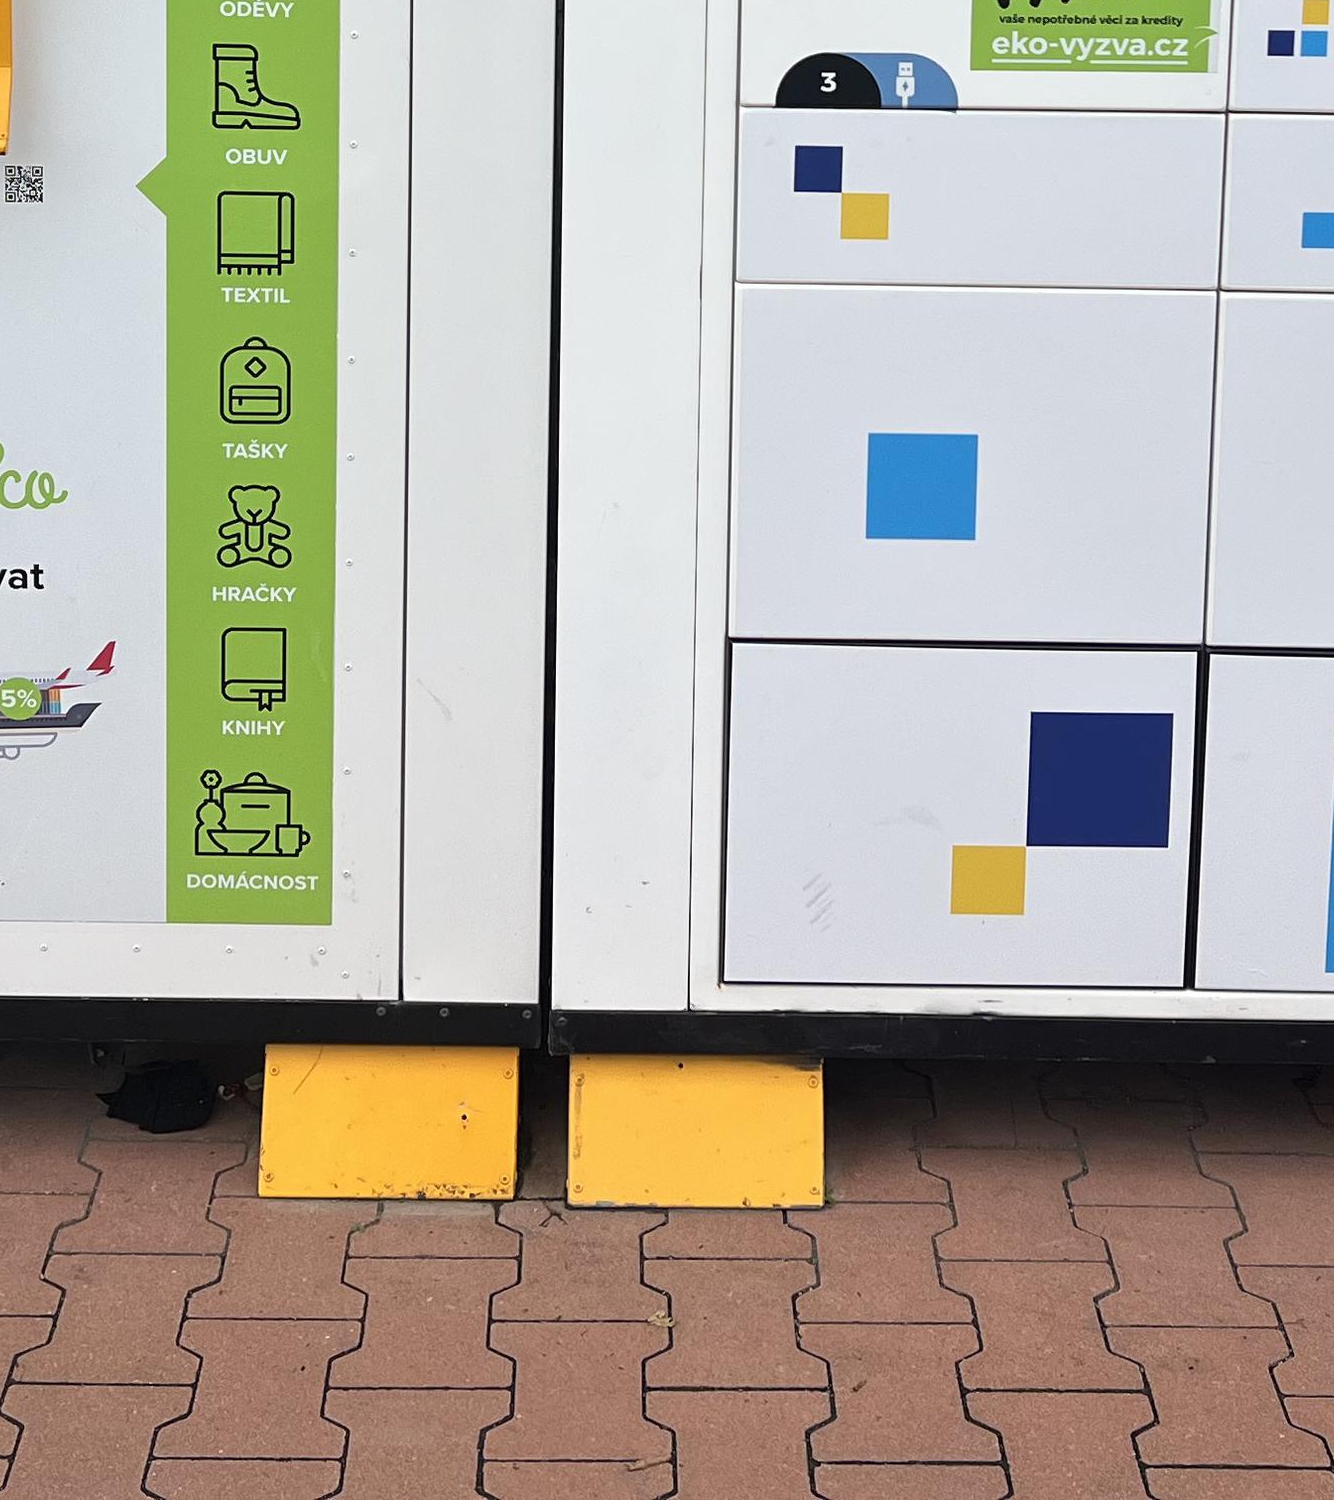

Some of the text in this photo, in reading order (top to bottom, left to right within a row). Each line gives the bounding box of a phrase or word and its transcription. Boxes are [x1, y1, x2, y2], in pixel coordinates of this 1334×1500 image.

[219, 0, 295, 20] ODĚVY
[999, 14, 1183, 27] vaše nepotřebné věci za kredity
[991, 31, 1189, 61] eko-vyzva.cz
[820, 72, 837, 92] 3
[224, 146, 288, 167] OBUV
[220, 285, 291, 305] TEXTIL
[222, 438, 289, 461] TAŠKY
[212, 582, 298, 604] HRAČKY
[1, 689, 37, 709] 5%
[222, 718, 286, 738] KNIHY
[186, 870, 319, 892] DOMÁCNOST
